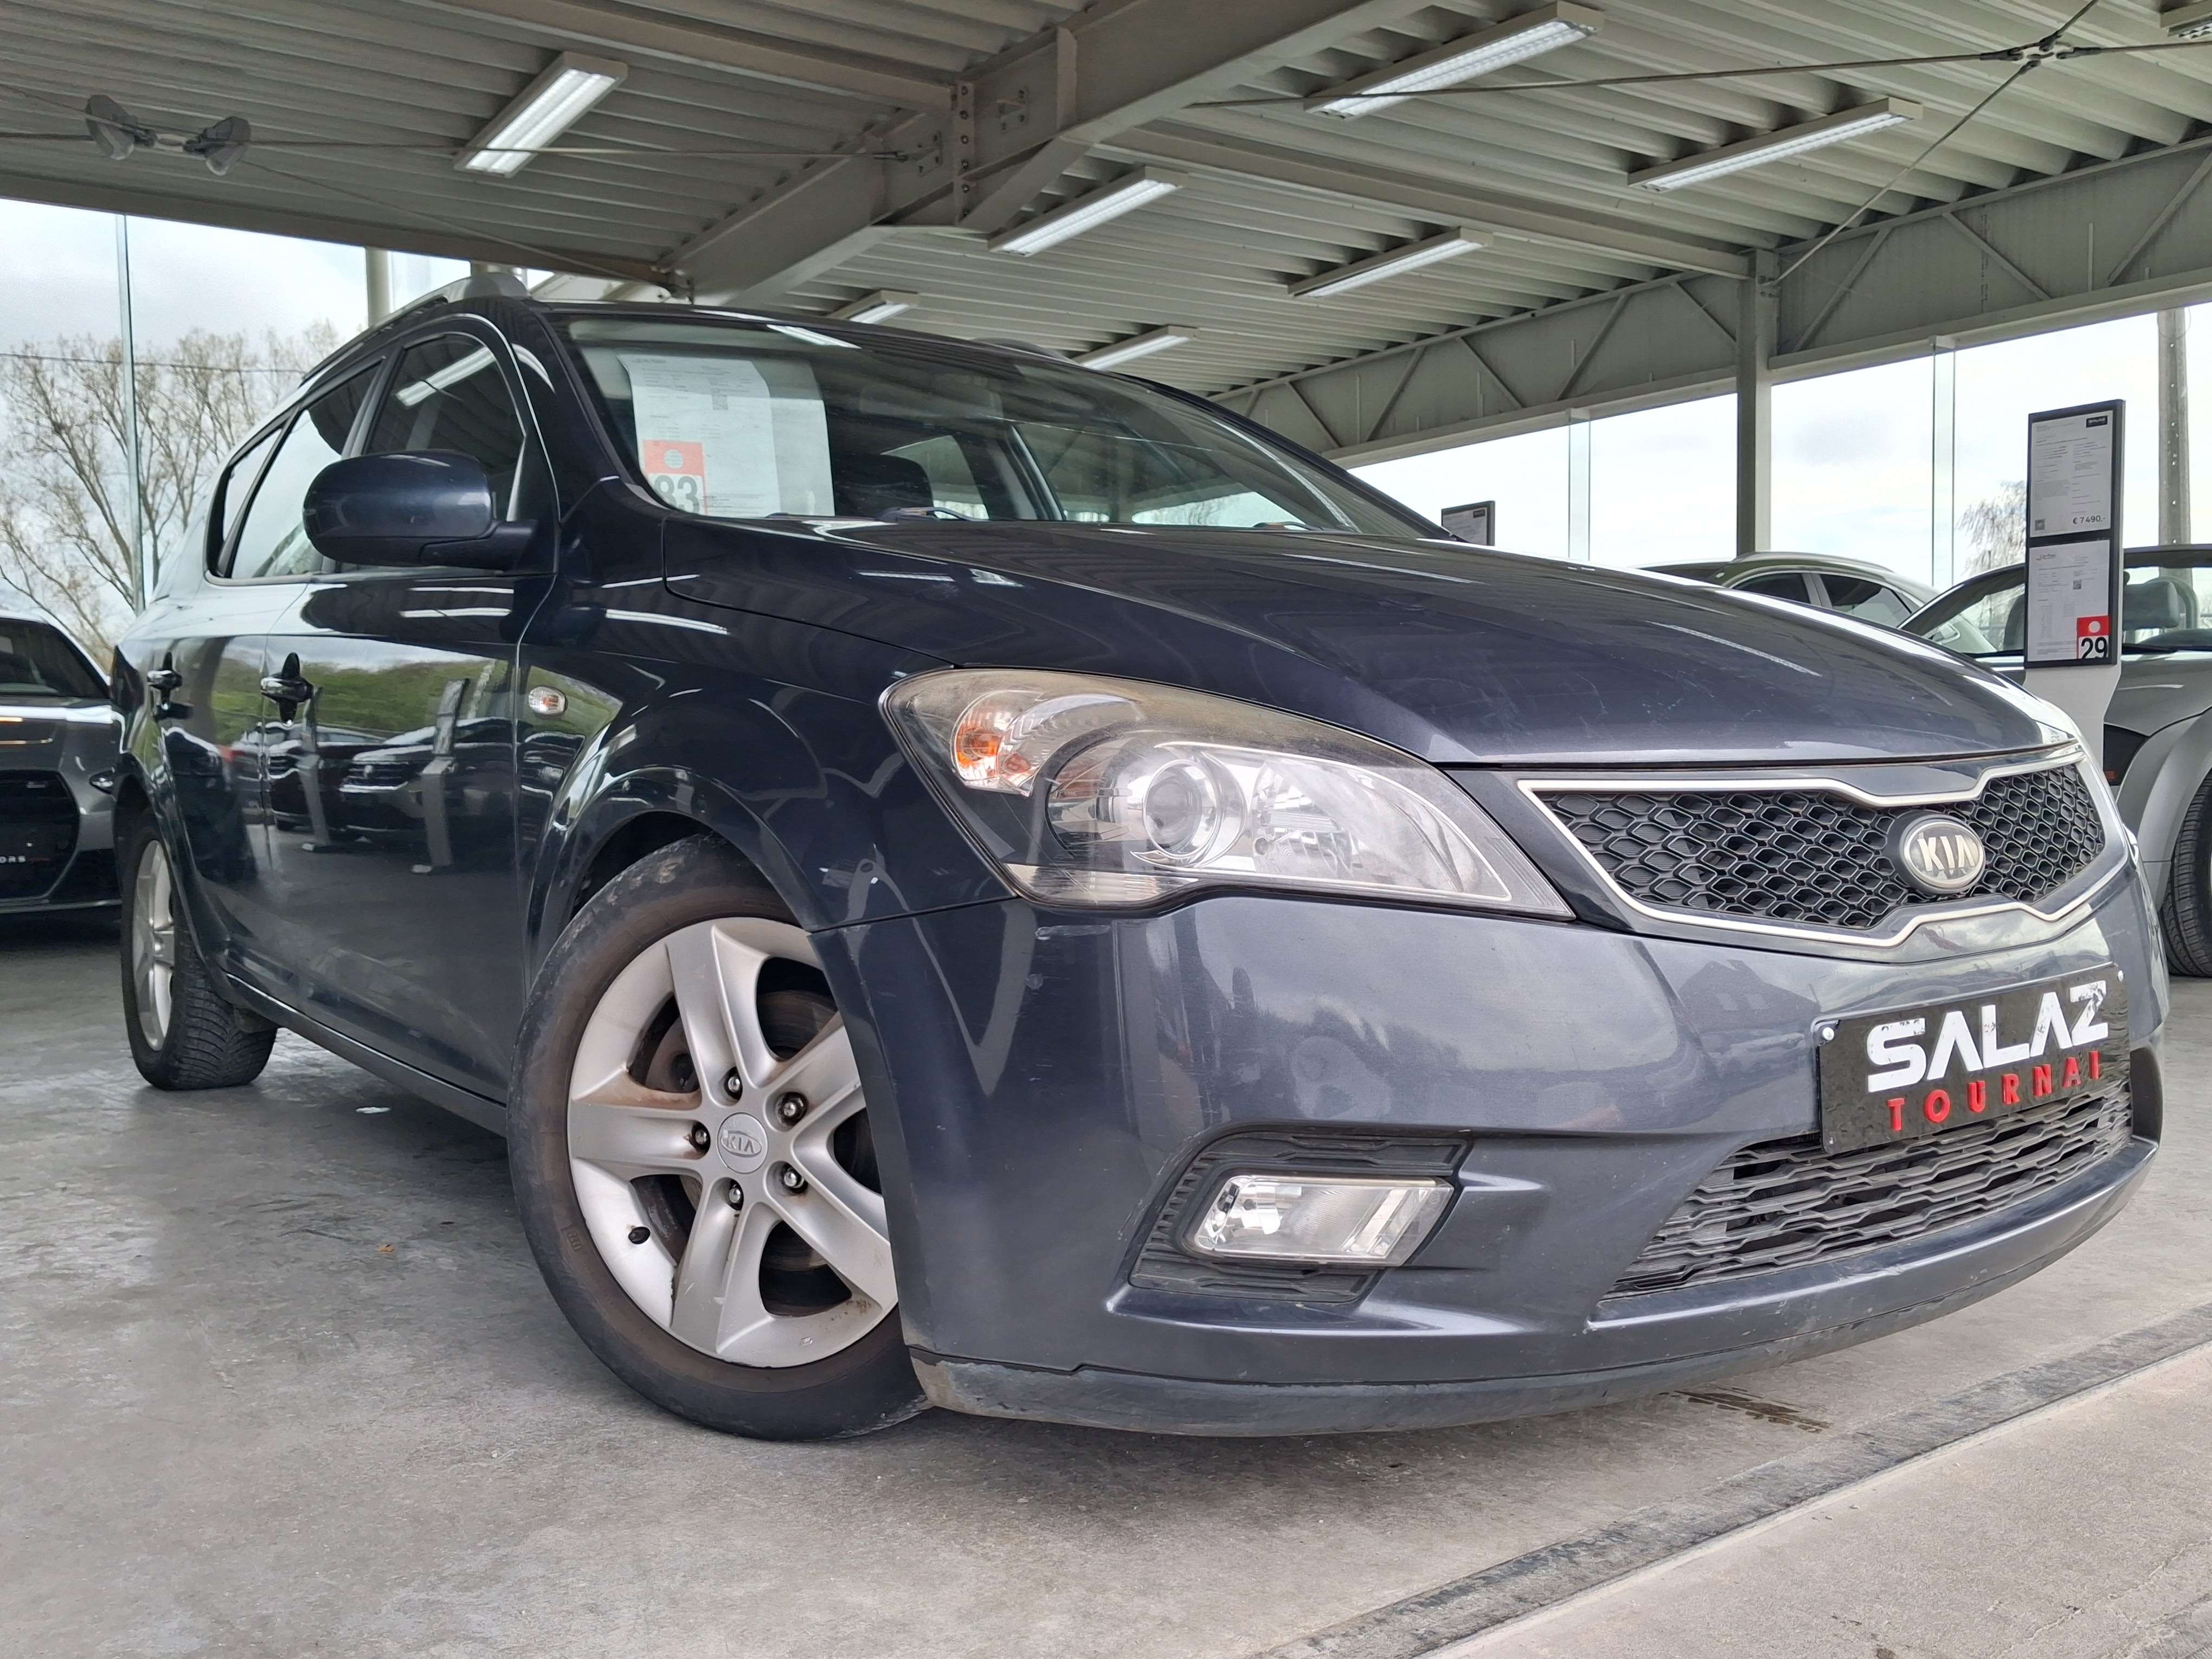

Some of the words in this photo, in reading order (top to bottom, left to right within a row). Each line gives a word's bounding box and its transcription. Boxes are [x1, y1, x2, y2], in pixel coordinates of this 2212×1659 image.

[2081, 636, 2108, 659] 29
[1917, 835, 1976, 872] KIA
[1866, 980, 2108, 1093] SALAZ
[1887, 1050, 2100, 1131] TOURNAI
[726, 1135, 755, 1154] KIA
